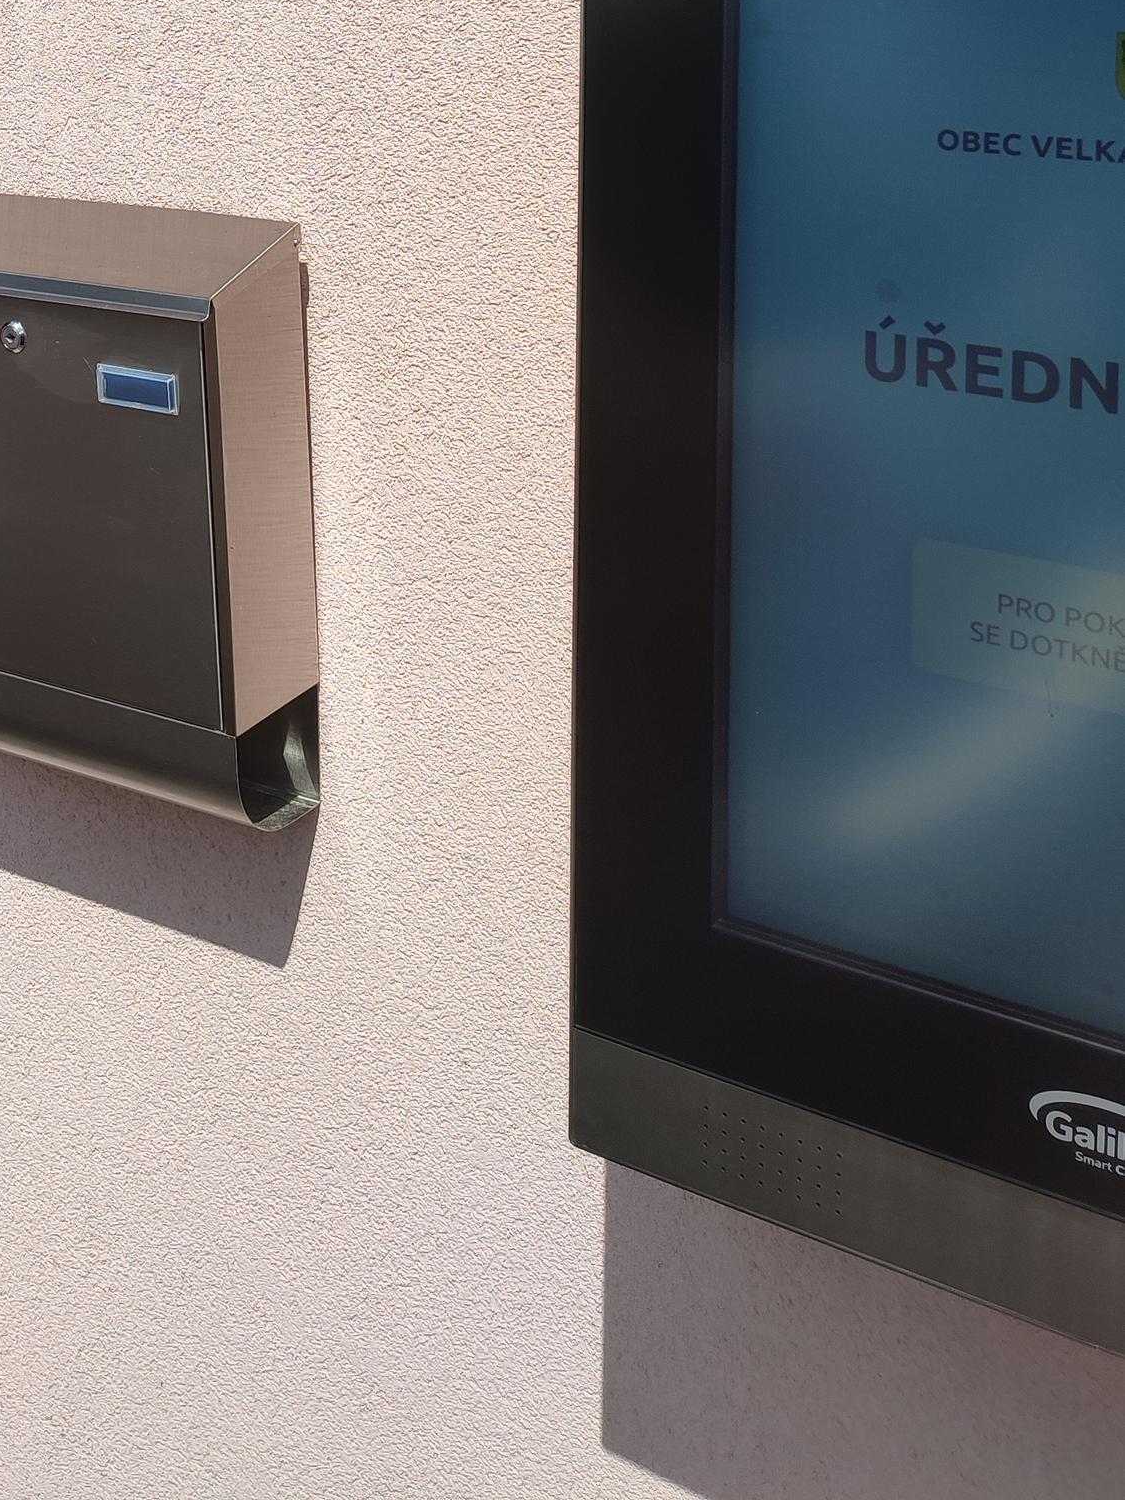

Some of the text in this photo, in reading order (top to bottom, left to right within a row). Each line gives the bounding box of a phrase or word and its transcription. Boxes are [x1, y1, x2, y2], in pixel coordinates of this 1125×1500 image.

[937, 128, 1022, 157] OBEC
[864, 315, 1120, 415] ÚŘEDN
[997, 593, 1125, 638] PRO POK
[970, 620, 1125, 673] SE DOTKNĚ
[1075, 1150, 1113, 1173] Smart
